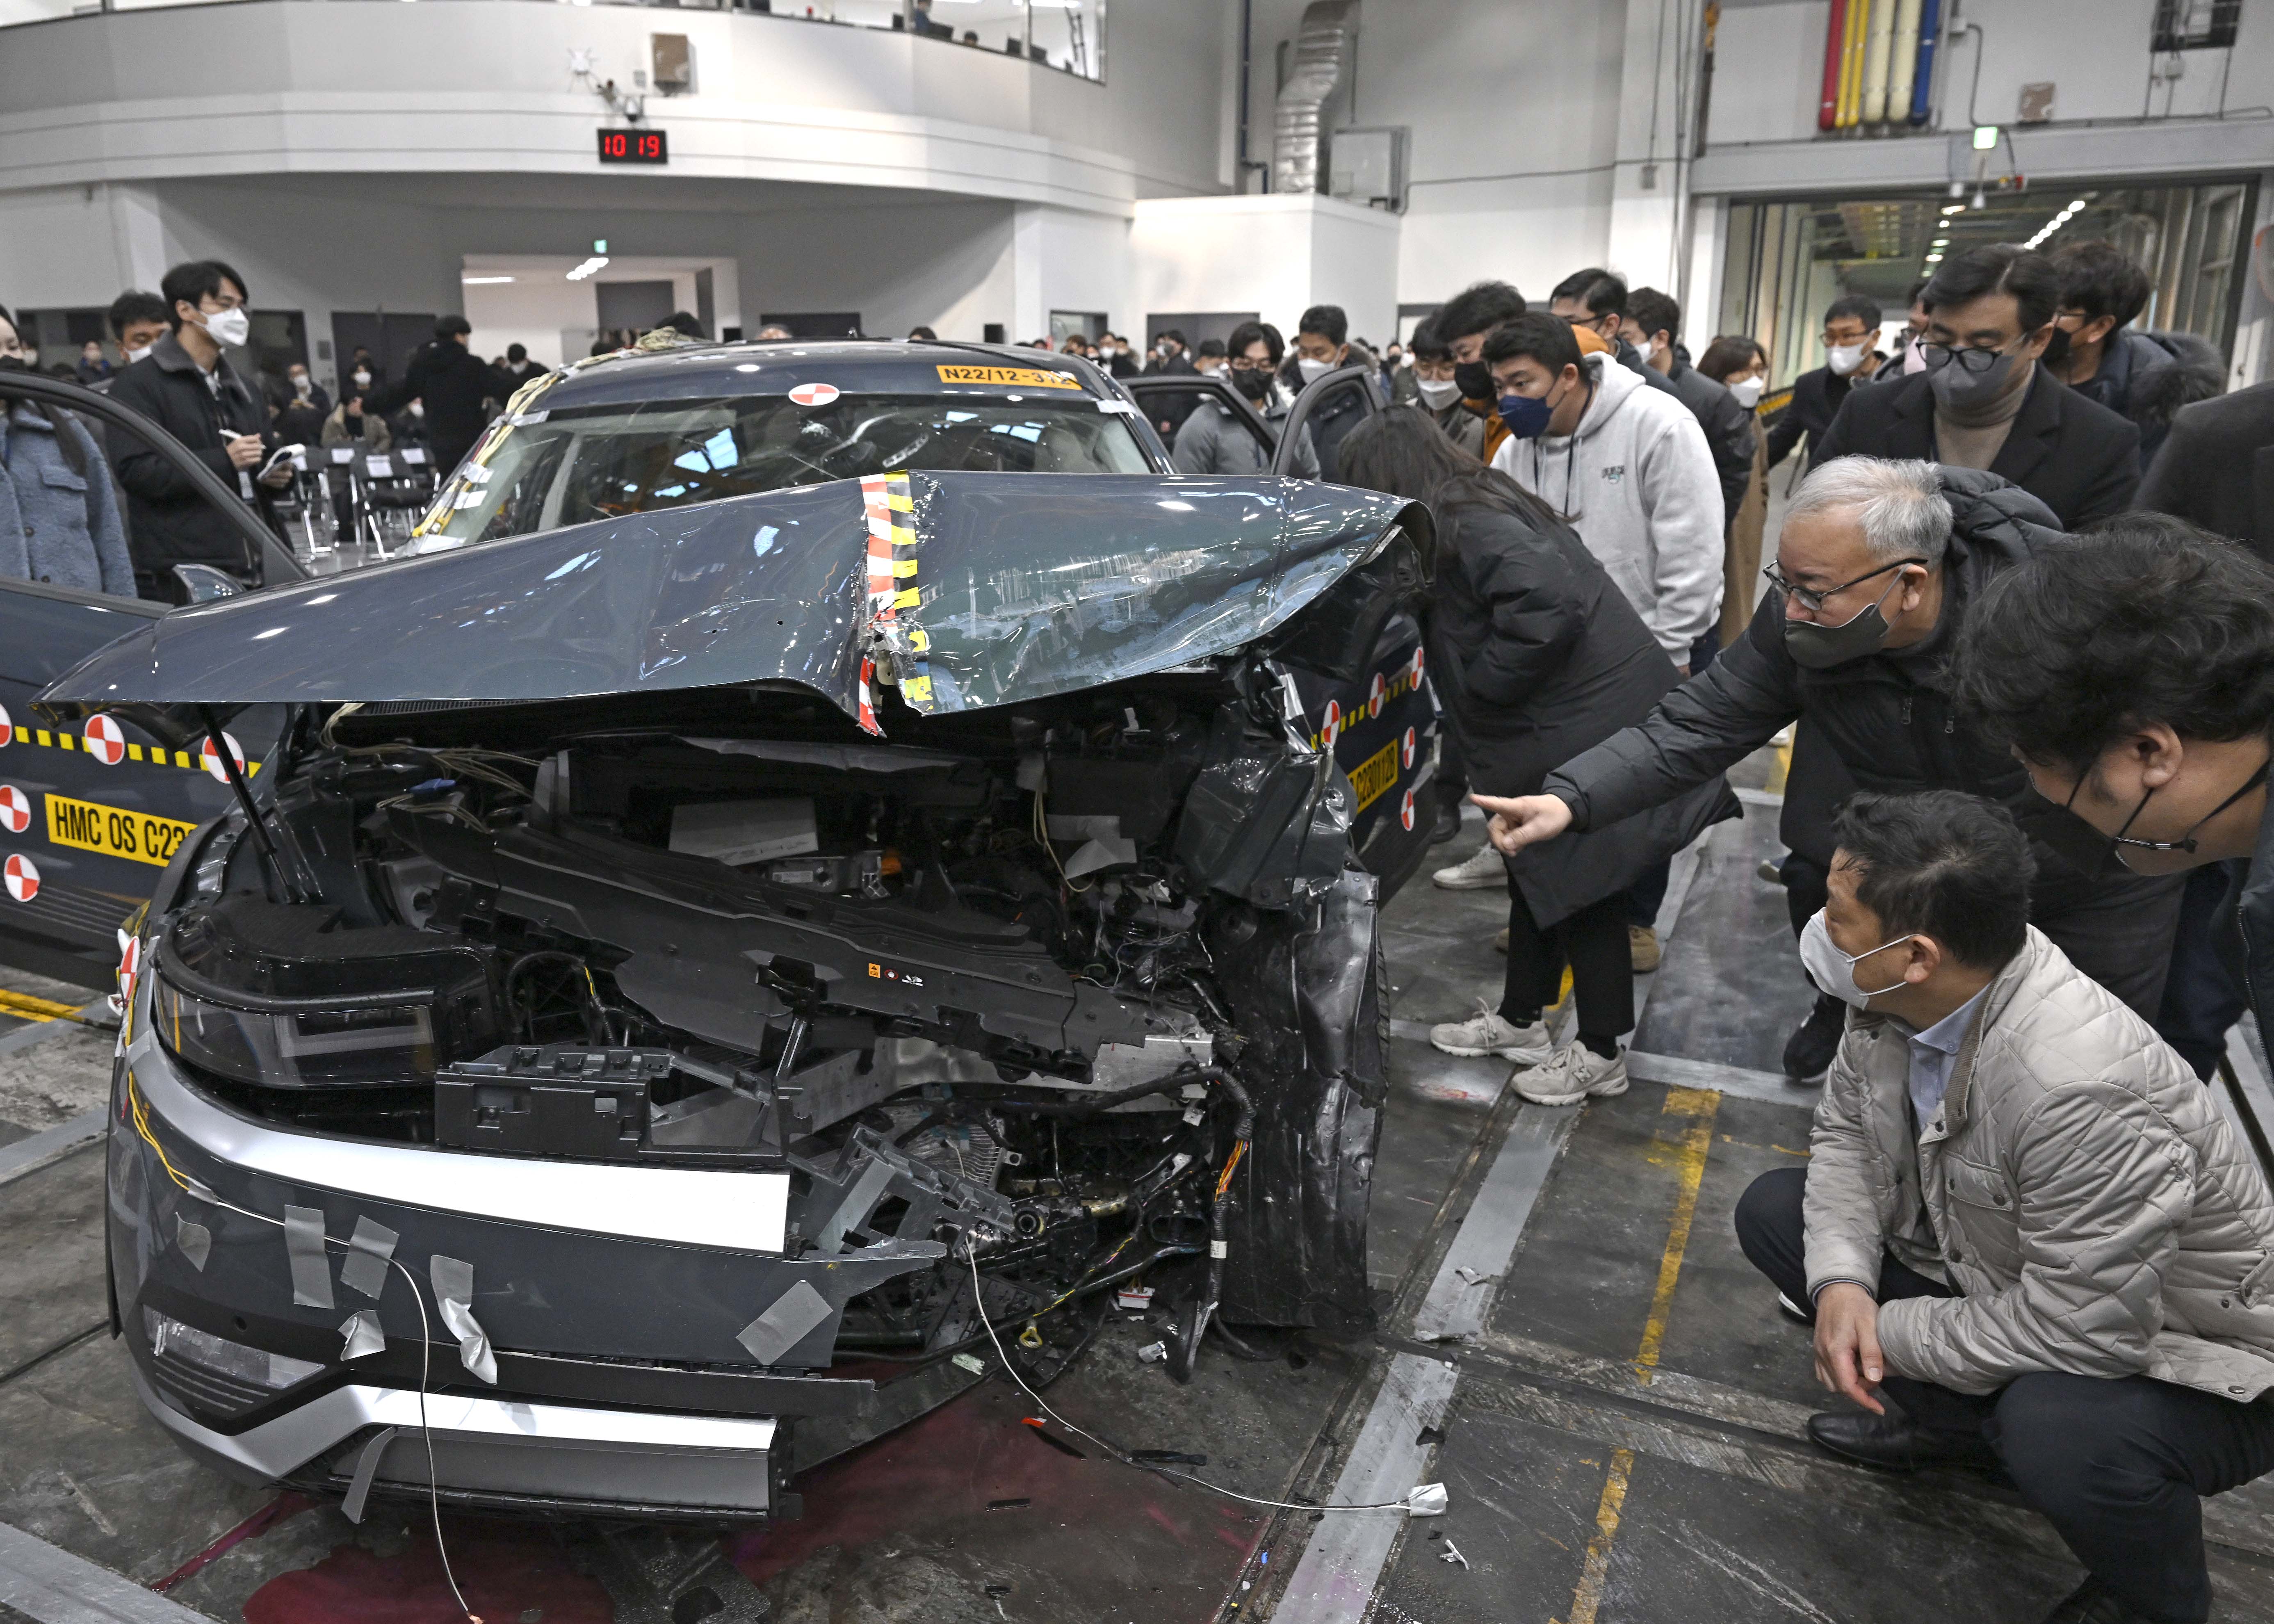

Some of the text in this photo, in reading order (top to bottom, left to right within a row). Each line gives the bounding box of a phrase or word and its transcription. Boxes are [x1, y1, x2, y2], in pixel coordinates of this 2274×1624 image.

[604, 134, 660, 157] 10 19
[55, 801, 194, 860] HMC OS C23
